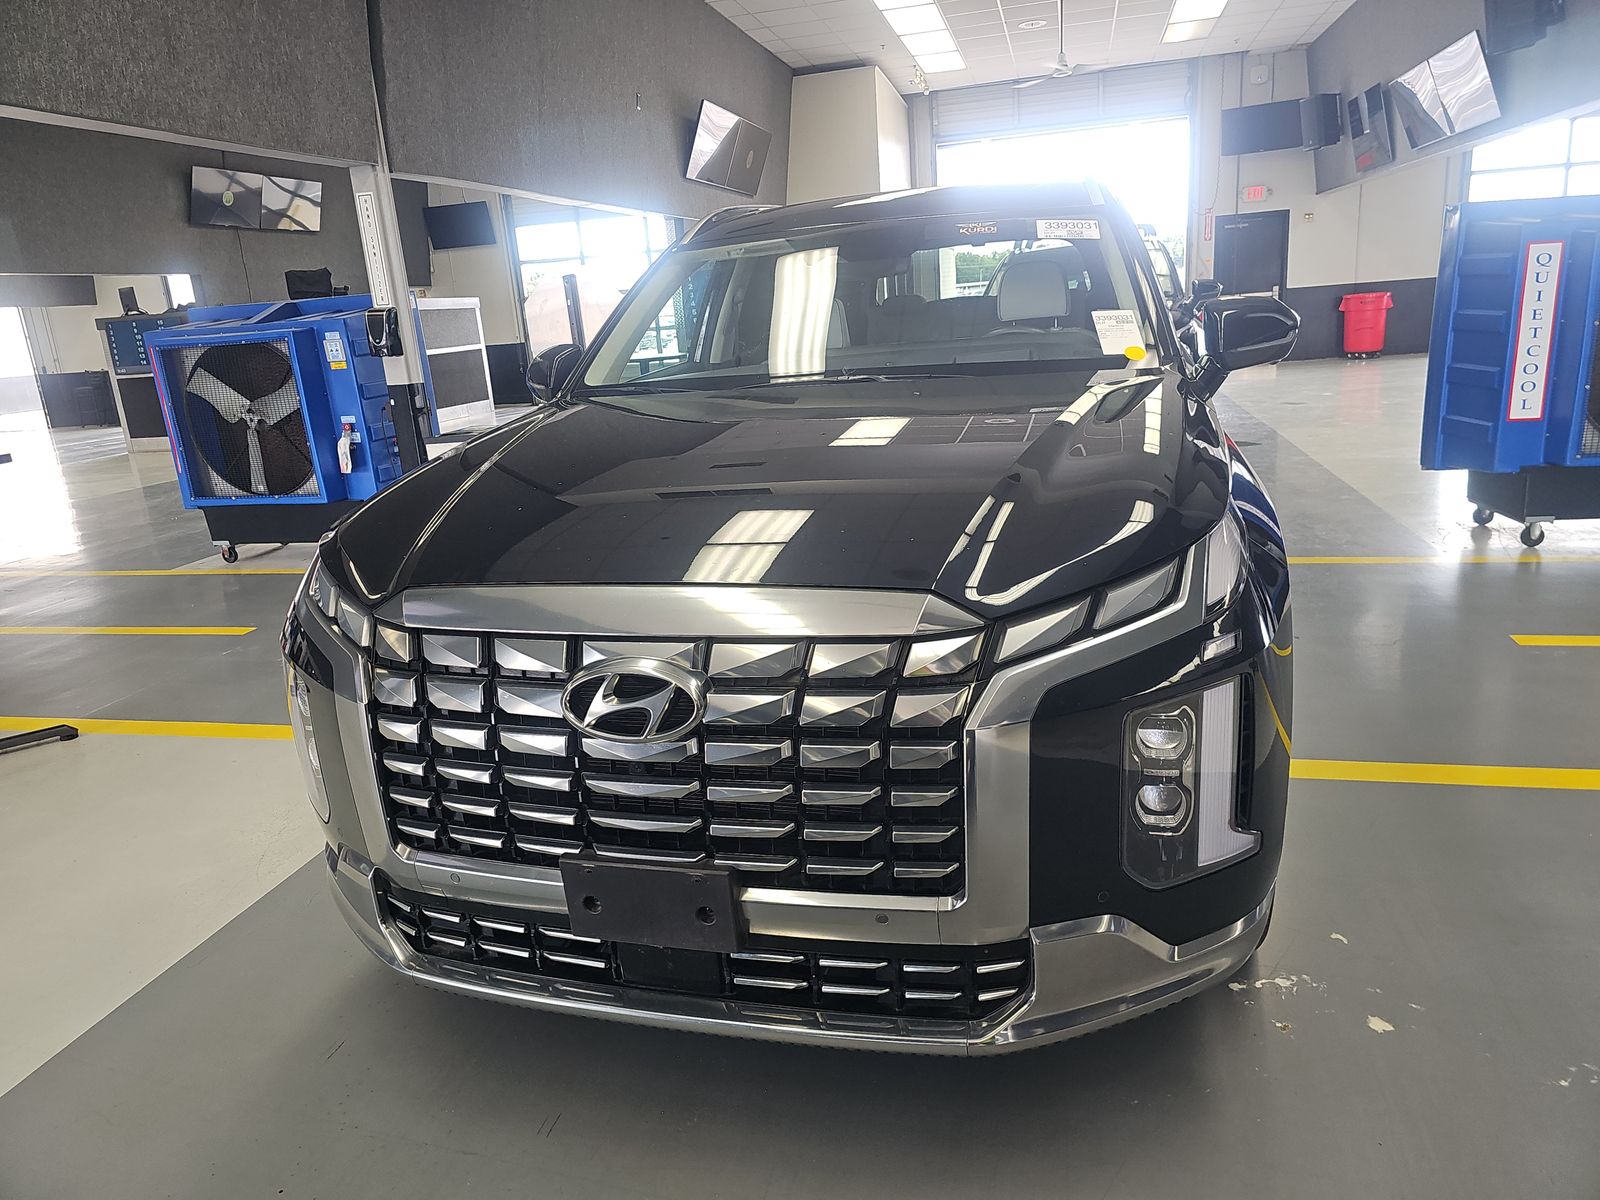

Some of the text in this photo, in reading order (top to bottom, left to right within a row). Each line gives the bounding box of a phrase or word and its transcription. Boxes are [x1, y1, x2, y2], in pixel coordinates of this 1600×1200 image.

[1247, 186, 1265, 200] EXIT
[364, 198, 372, 228] HAND
[1044, 221, 1098, 230] 3393031
[1520, 252, 1553, 410] QUIETCOOL
